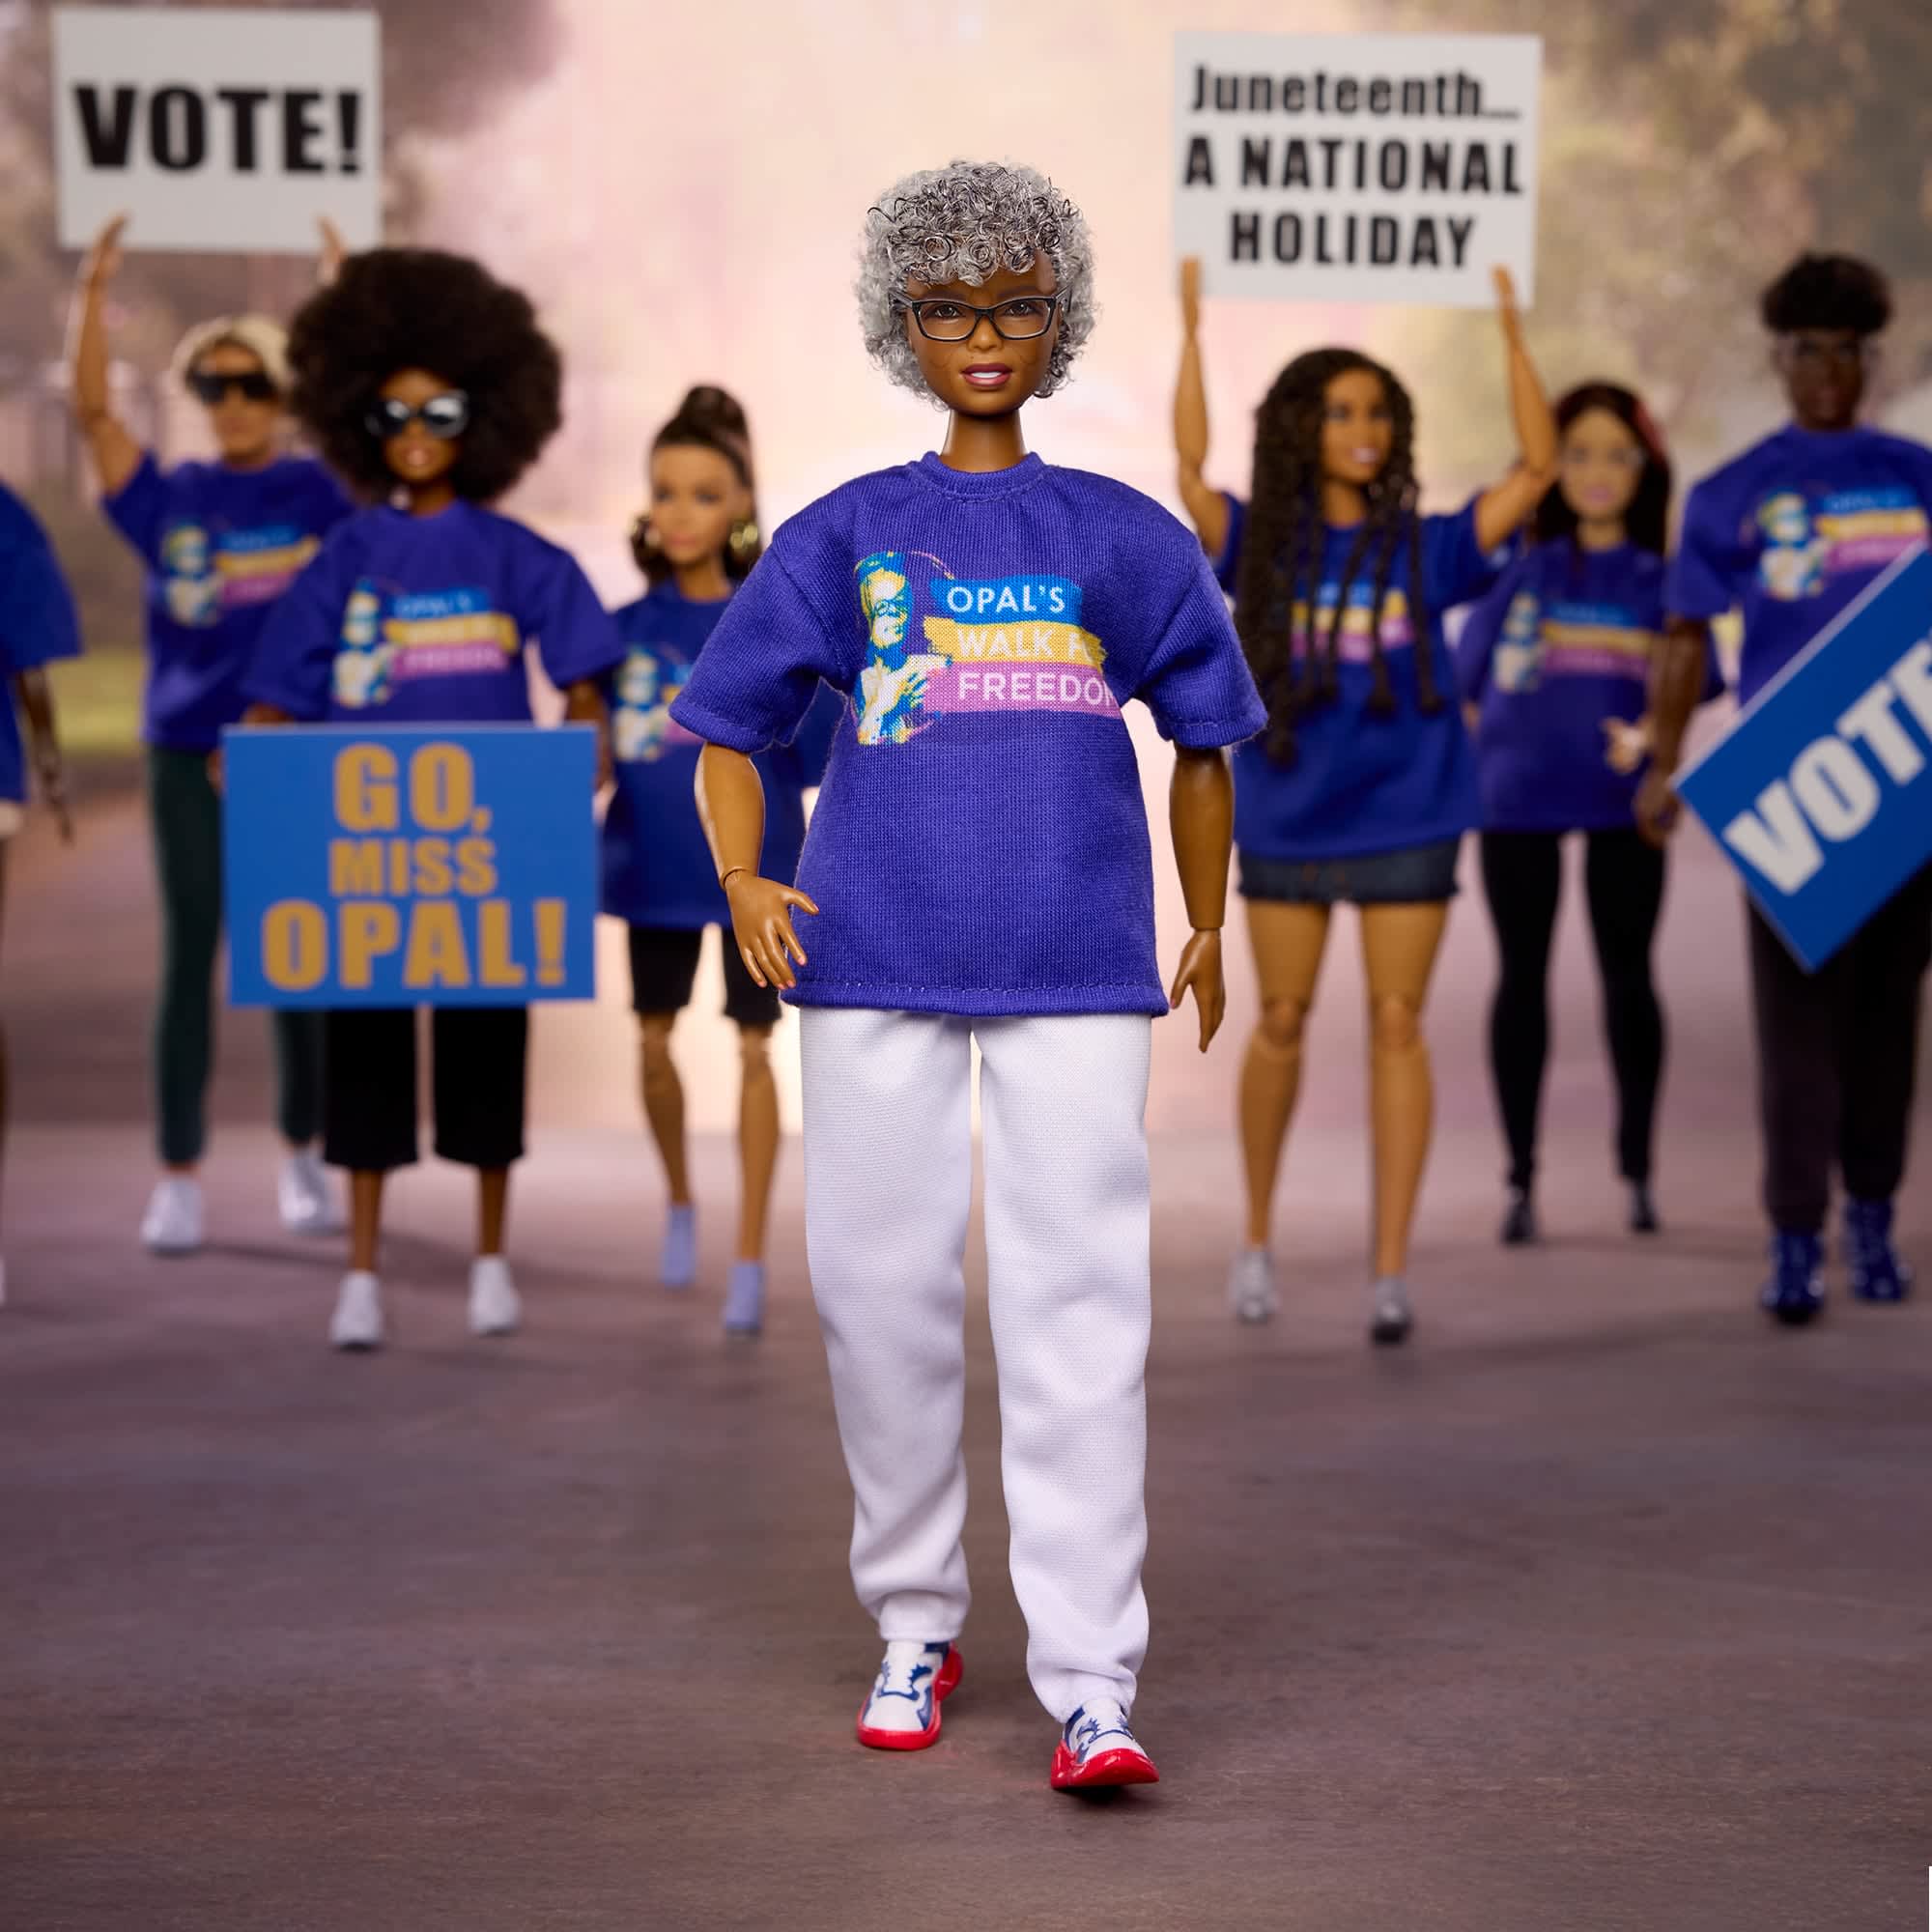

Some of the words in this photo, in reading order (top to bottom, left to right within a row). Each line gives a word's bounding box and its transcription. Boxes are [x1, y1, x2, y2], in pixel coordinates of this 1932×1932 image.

[71, 82, 362, 176] VOTE!
[1184, 134, 1216, 188] A
[1240, 136, 1522, 195] NATIONAL
[1230, 210, 1474, 269] HOLIDAY
[947, 584, 1065, 613] OPAL'S
[956, 627, 1055, 659] WALK
[333, 742, 492, 835] GO,
[328, 837, 497, 897] MISS
[262, 898, 566, 991] OPAL!
